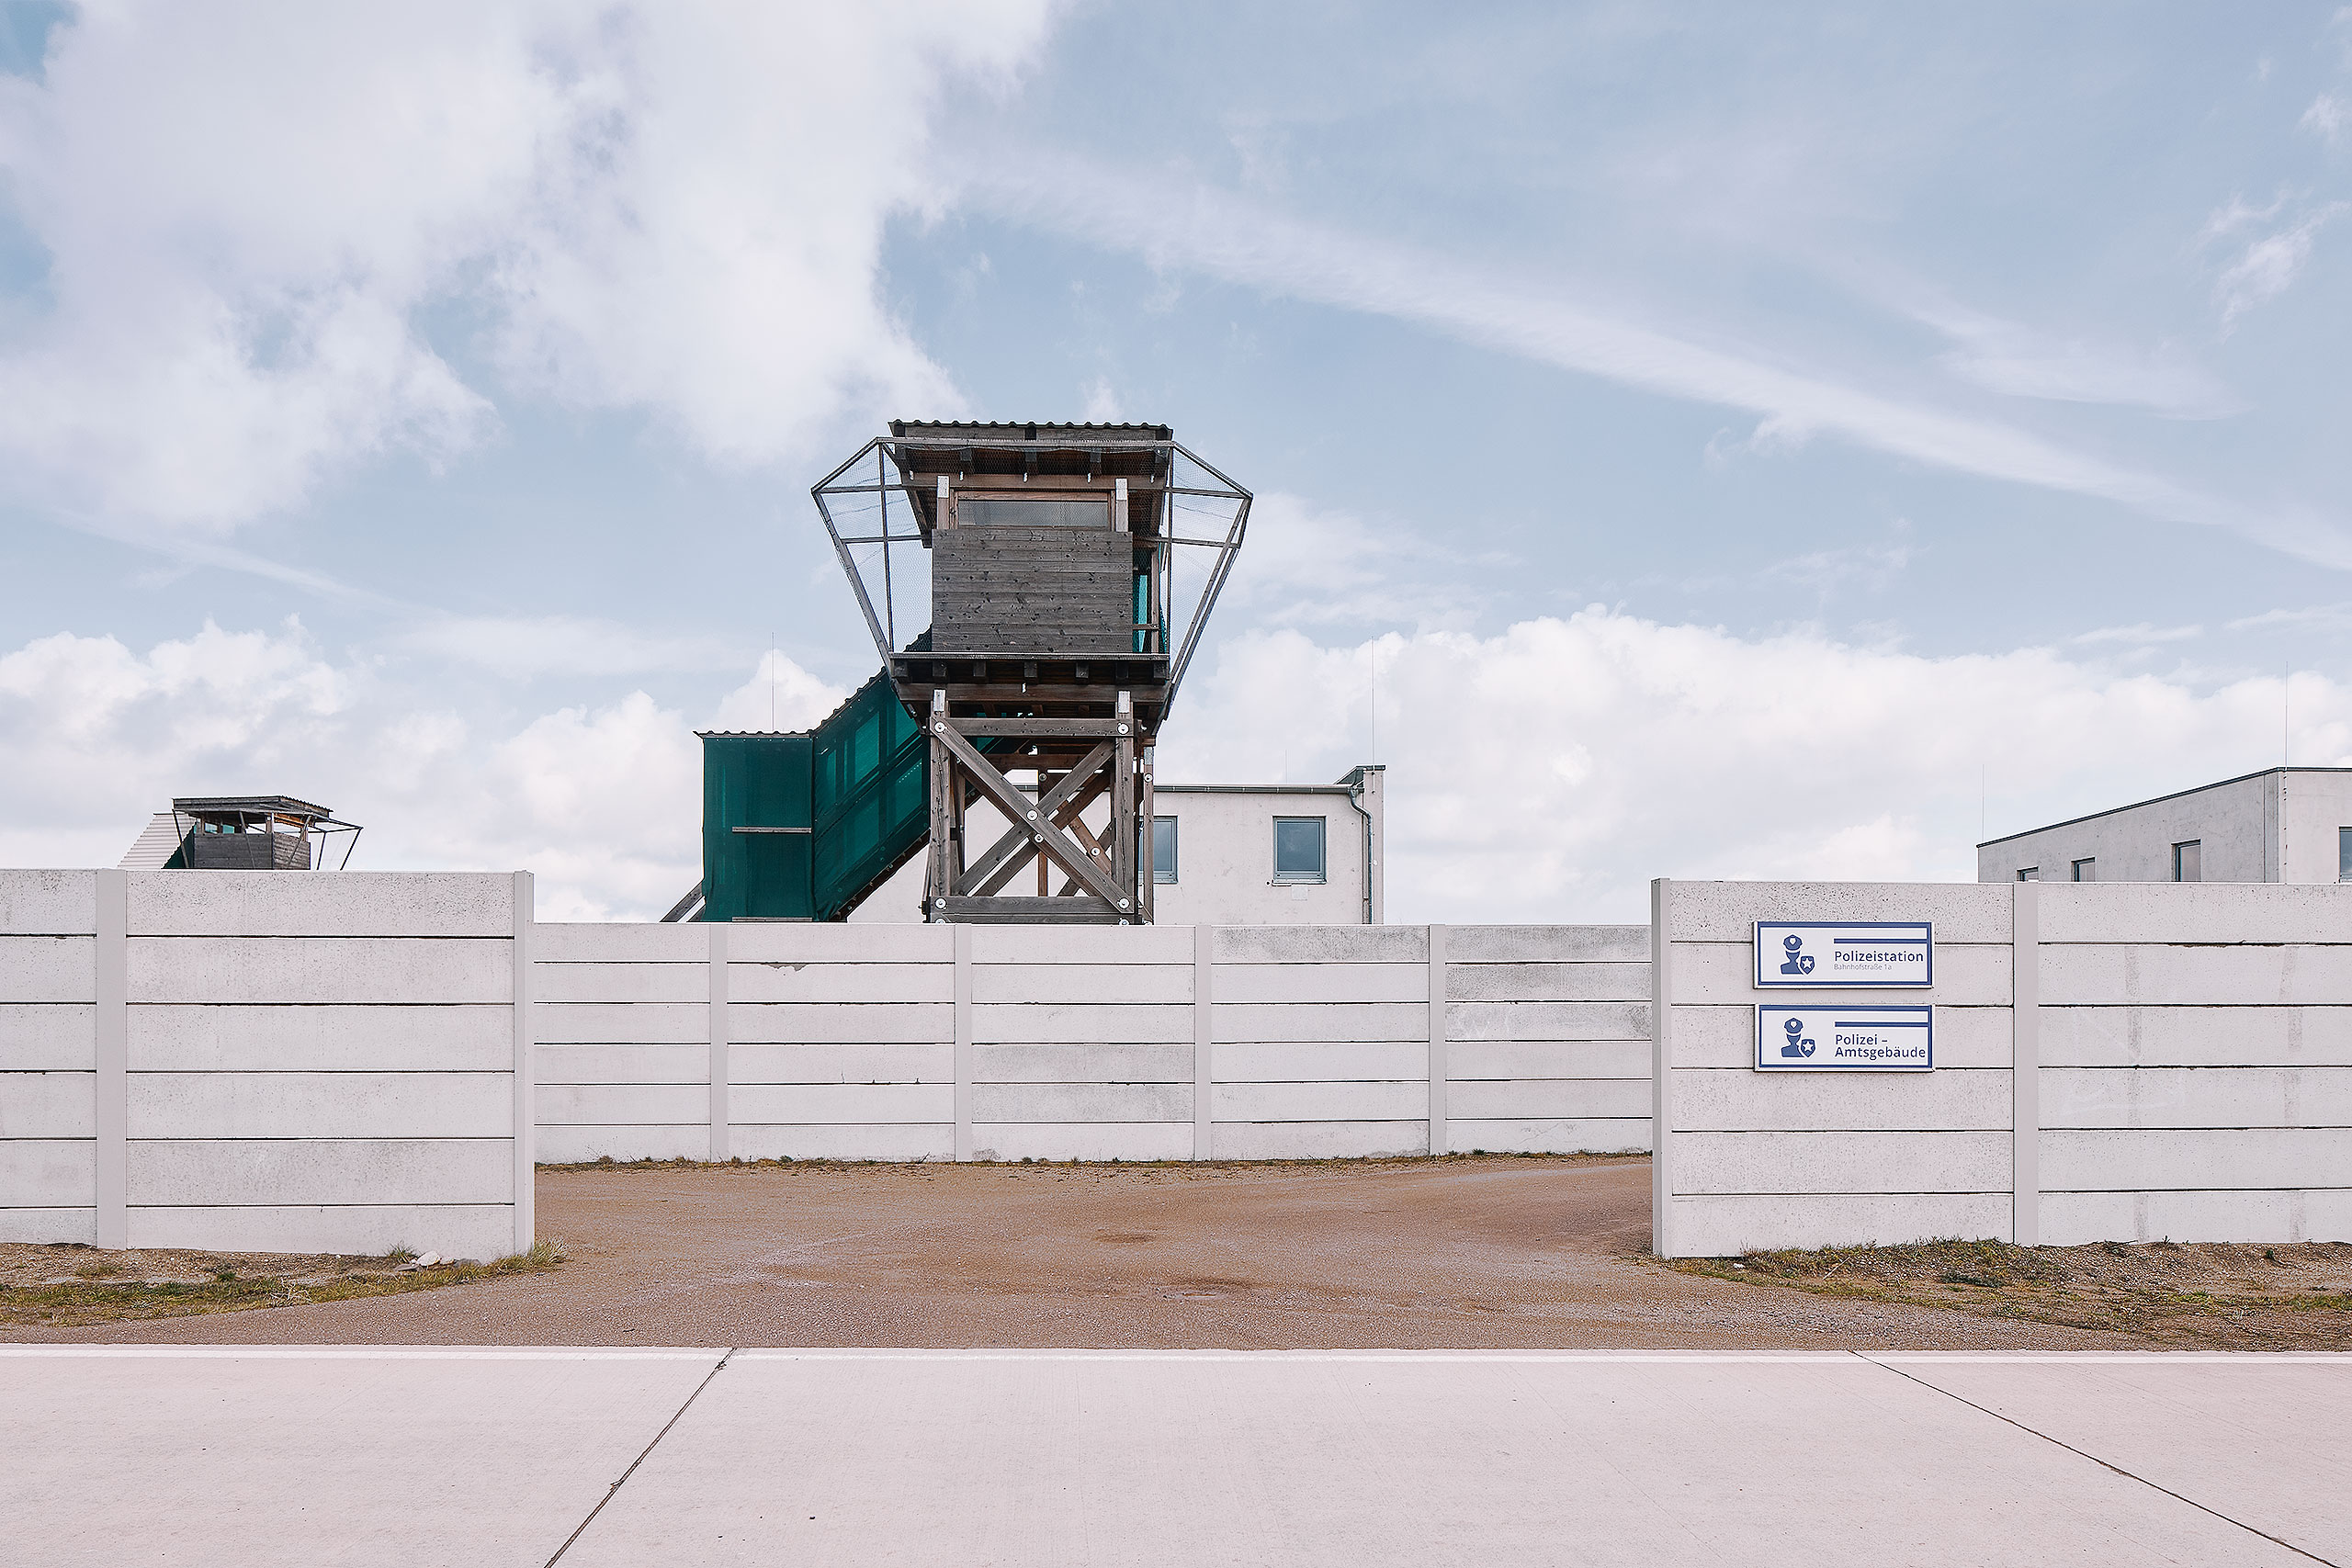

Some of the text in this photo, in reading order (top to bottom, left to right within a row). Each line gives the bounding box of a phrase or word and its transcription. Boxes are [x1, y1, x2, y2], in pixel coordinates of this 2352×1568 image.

[1835, 951, 1924, 962] Polizeistation
[1835, 1034, 1878, 1045] Polizei
[1835, 1046, 1926, 1060] Amtsgebäude
